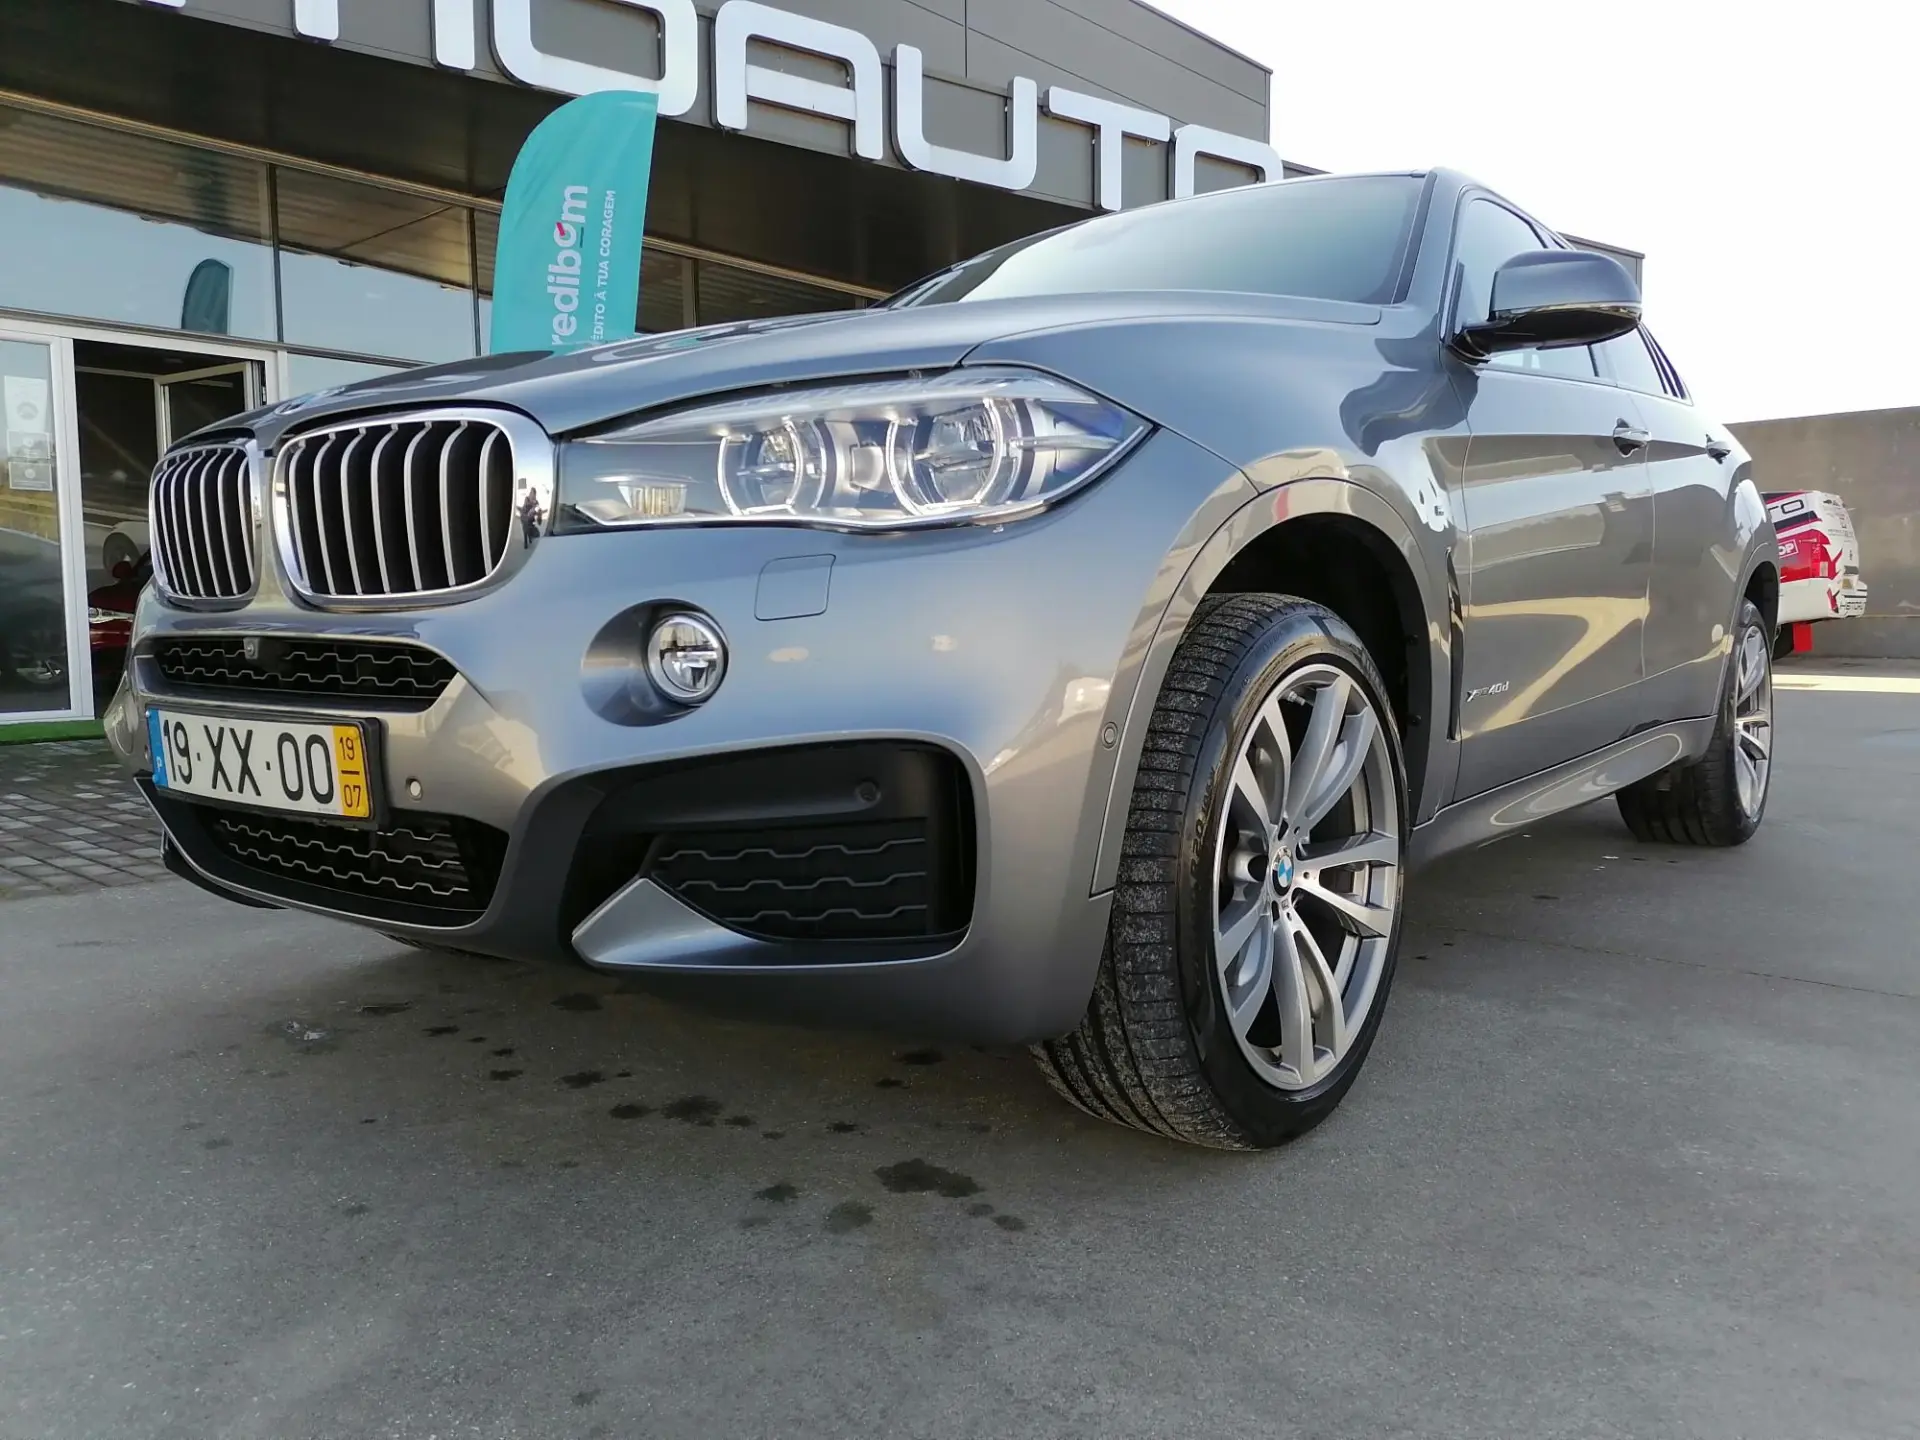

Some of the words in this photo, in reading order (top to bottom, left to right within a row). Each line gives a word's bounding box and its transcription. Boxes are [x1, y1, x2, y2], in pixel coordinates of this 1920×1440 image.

[599, 190, 617, 257] CORAGEM
[597, 260, 609, 288] TUA
[339, 736, 355, 761] 19
[343, 784, 362, 809] 07
